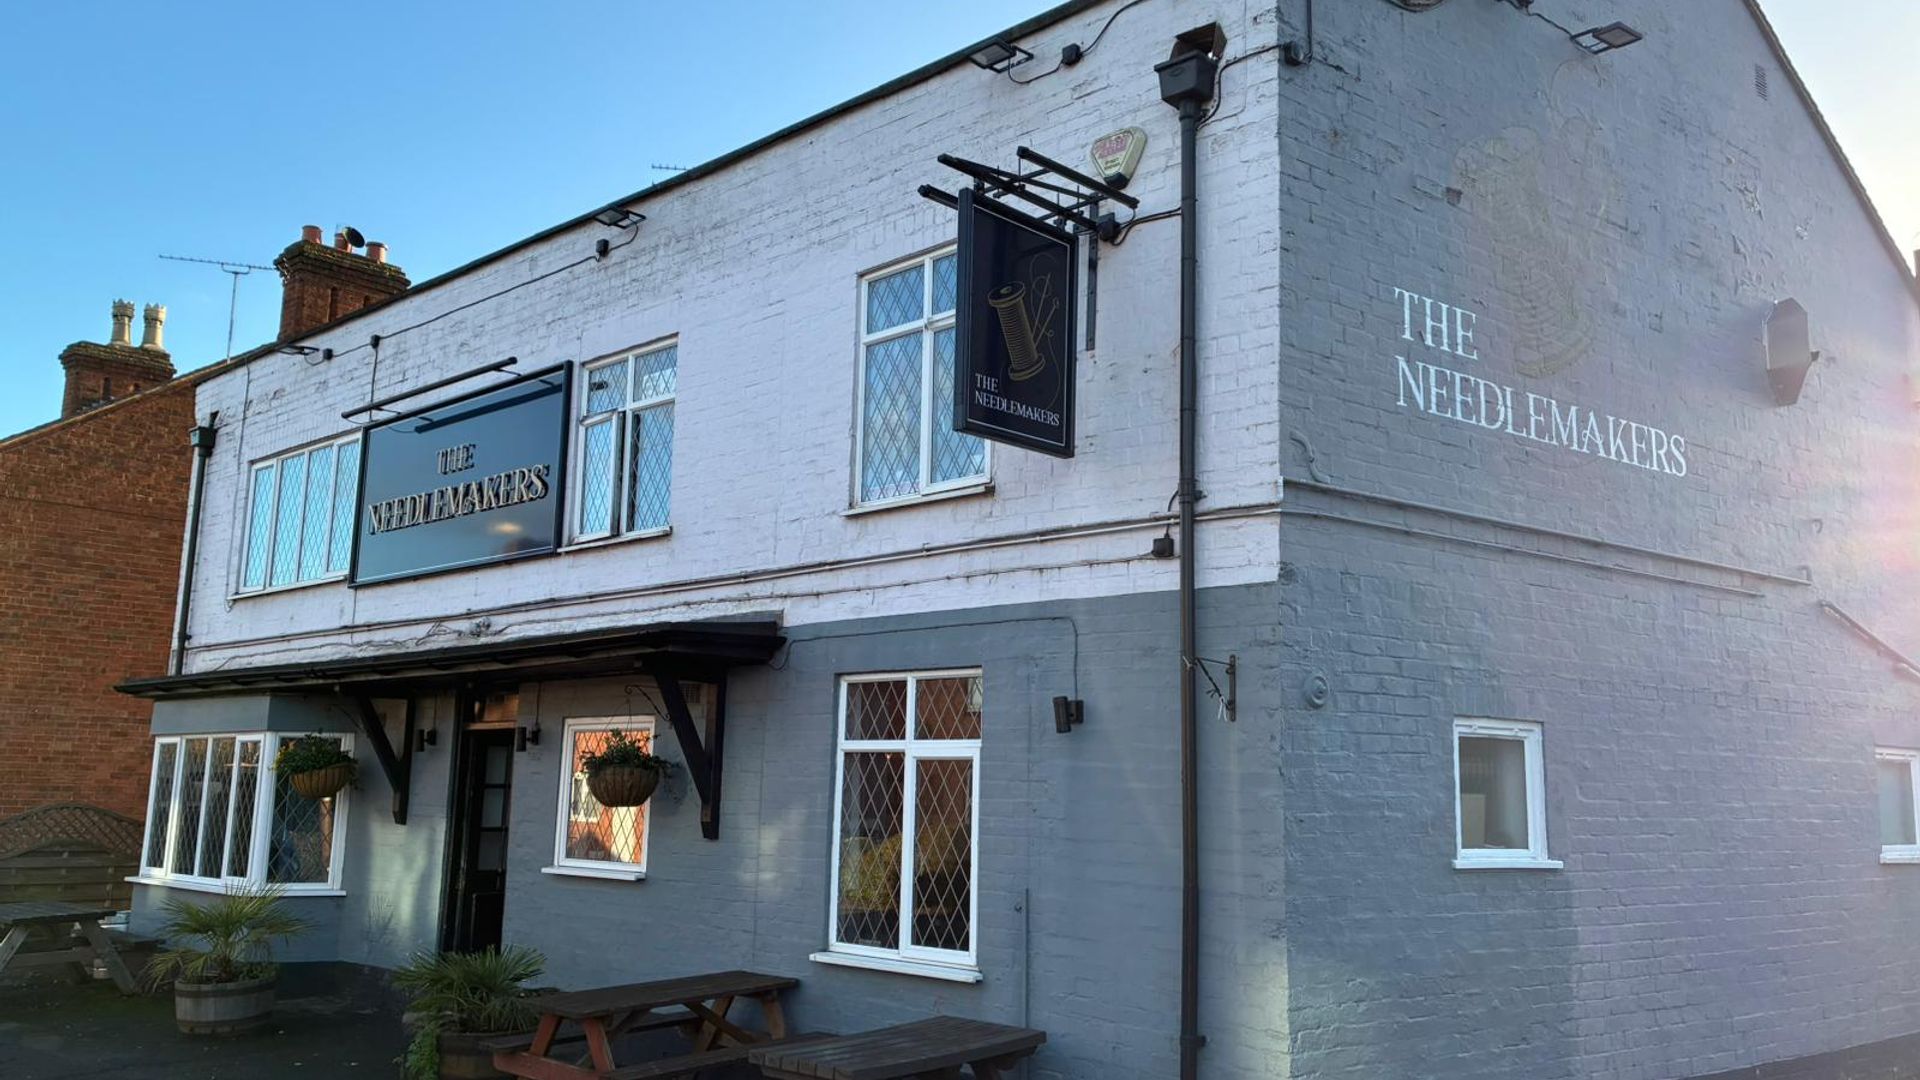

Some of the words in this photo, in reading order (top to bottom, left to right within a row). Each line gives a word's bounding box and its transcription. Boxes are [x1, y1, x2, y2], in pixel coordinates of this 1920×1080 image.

[1394, 287, 1478, 360] THE
[975, 373, 999, 392] THE
[975, 390, 1060, 425] NEEDLEMAKERS
[1394, 356, 1687, 477] NEEDLEMAKERS
[436, 444, 475, 474] THE
[368, 464, 549, 534] NEEDLEMAKERS
